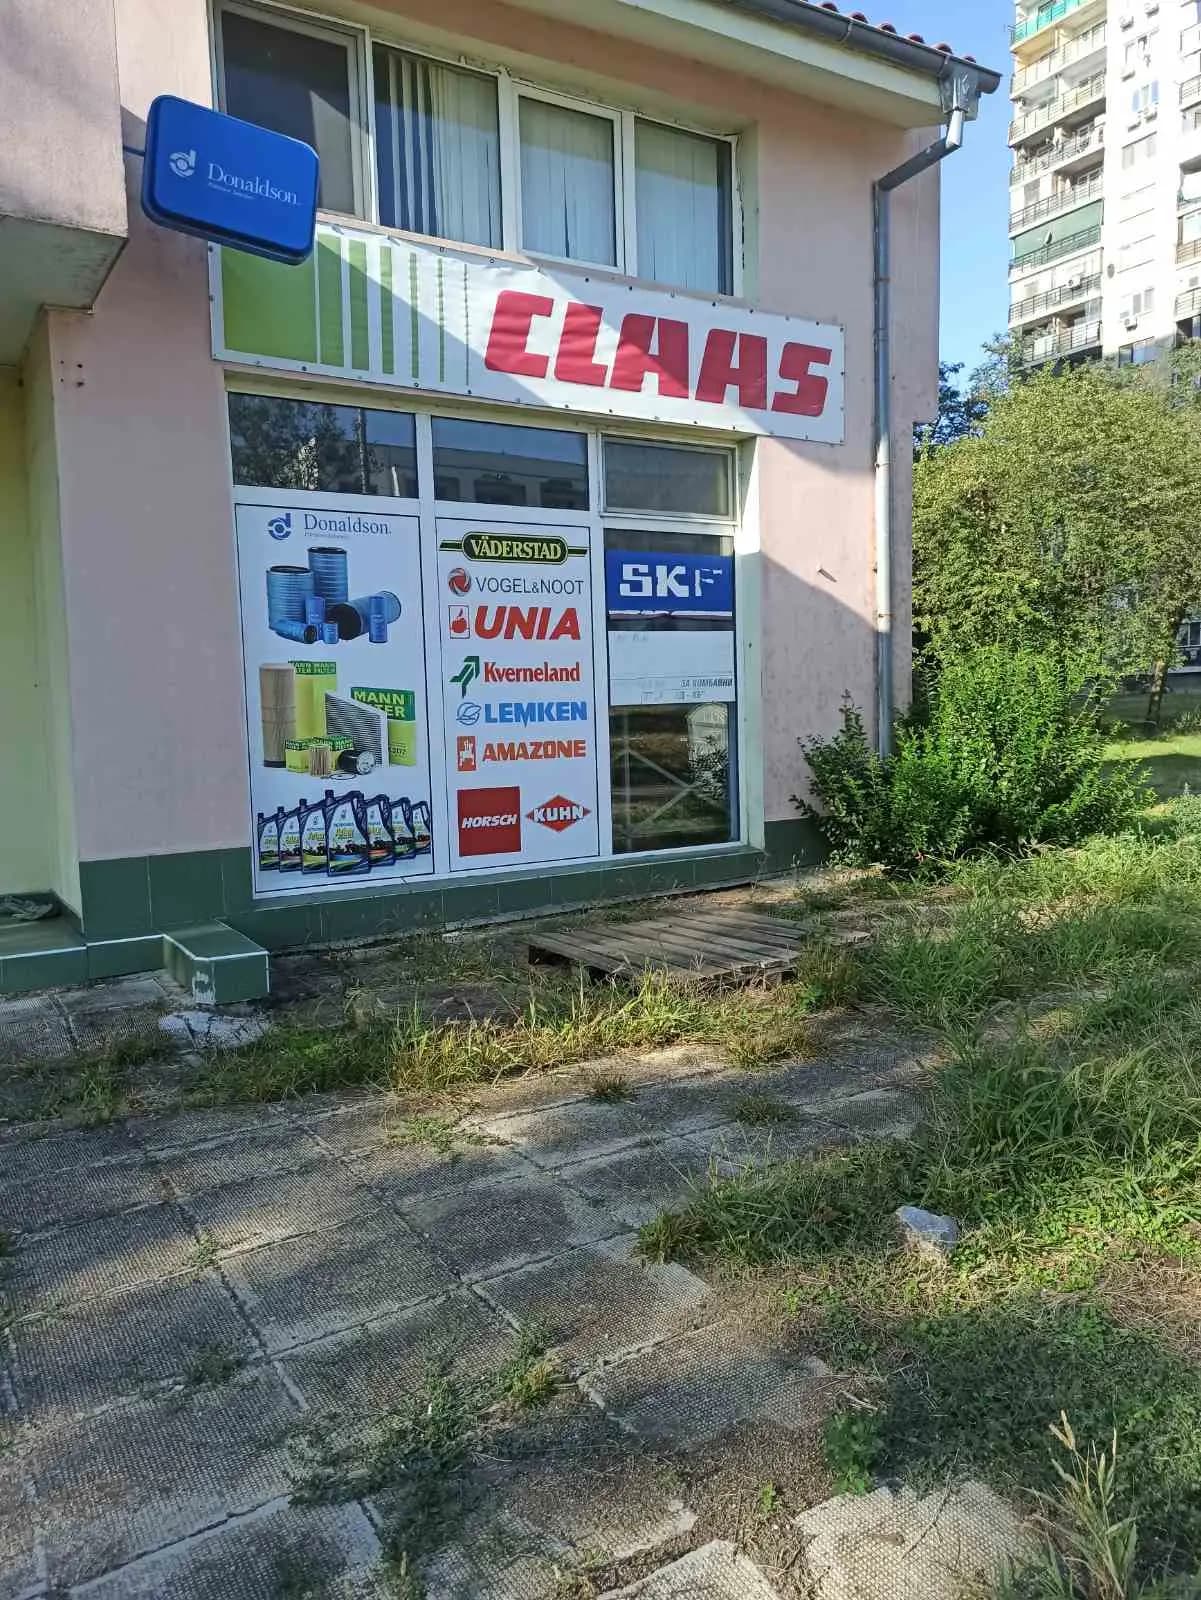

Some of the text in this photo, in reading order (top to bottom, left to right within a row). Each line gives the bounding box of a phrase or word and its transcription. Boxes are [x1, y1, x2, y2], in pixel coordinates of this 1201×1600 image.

[208, 163, 298, 206] Donaldson
[485, 290, 831, 417] CLAAS
[471, 537, 562, 559] VÄDERSTAD
[475, 576, 584, 596] VOGEL&NOOT
[619, 564, 722, 597] SKF
[475, 605, 580, 641] UNIA
[484, 662, 580, 683] Kverneland
[354, 691, 404, 704] MANN
[485, 702, 587, 727] LEMKEN
[483, 740, 586, 761] AMAZONE
[462, 814, 517, 829] HORSCH
[533, 806, 584, 823] KUHN
